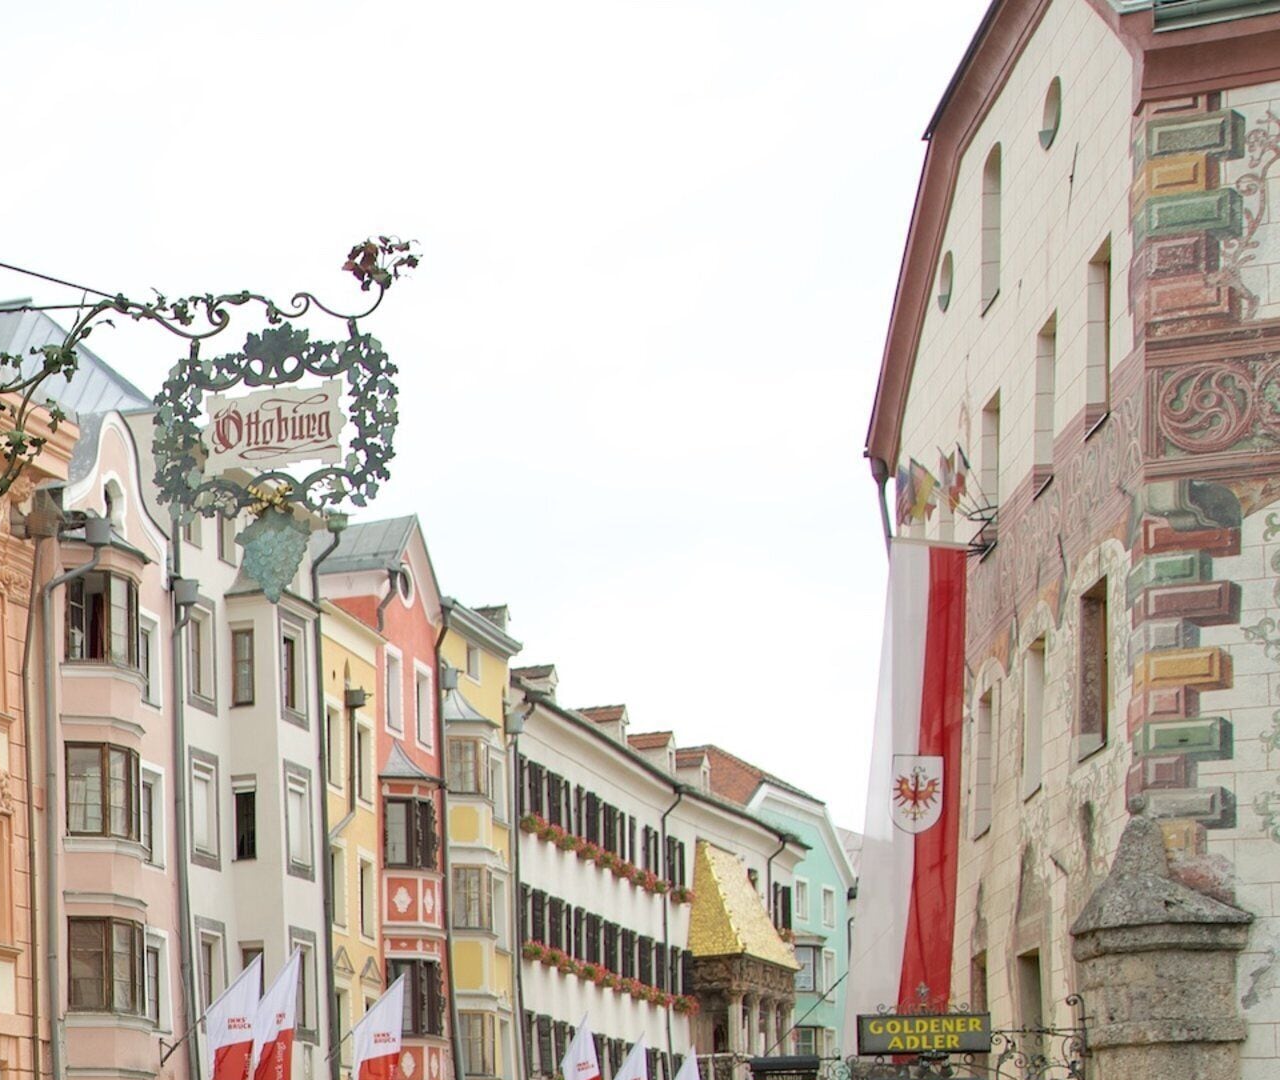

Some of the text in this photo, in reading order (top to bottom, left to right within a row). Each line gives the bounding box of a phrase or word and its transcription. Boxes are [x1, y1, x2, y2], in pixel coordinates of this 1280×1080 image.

[211, 402, 333, 454] Ottoburg
[869, 1018, 982, 1034] GOLDENER
[888, 1035, 960, 1050] ADLER
